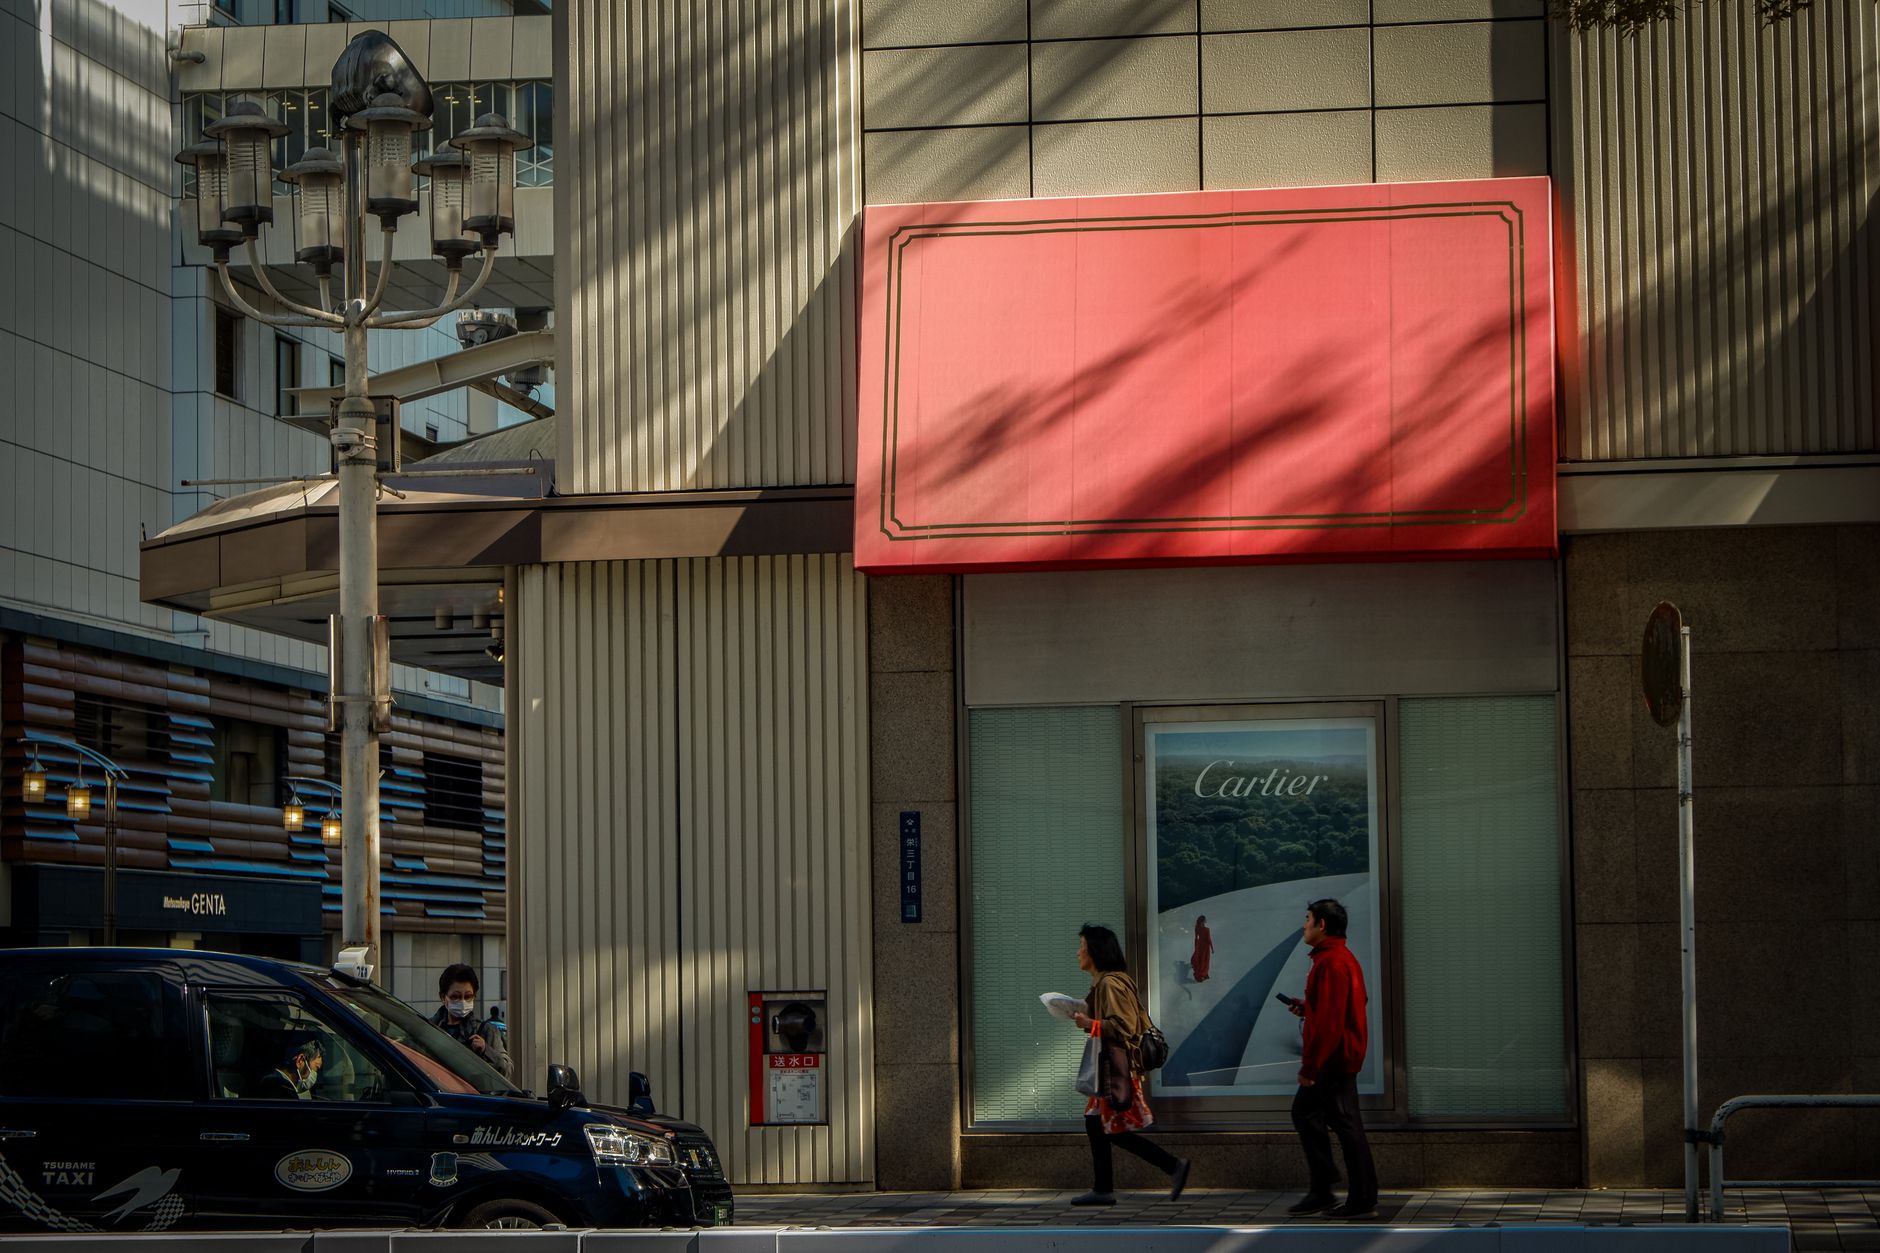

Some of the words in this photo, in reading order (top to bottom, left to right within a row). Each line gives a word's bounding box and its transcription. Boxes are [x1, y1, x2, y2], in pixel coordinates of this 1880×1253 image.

[1194, 759, 1329, 798] Cartier
[191, 892, 226, 916] GENTA
[774, 1055, 814, 1067] 送水口
[470, 1125, 562, 1147] あんしんネットワーク
[42, 1161, 96, 1170] TSUBAME
[42, 1171, 94, 1185] TAXI
